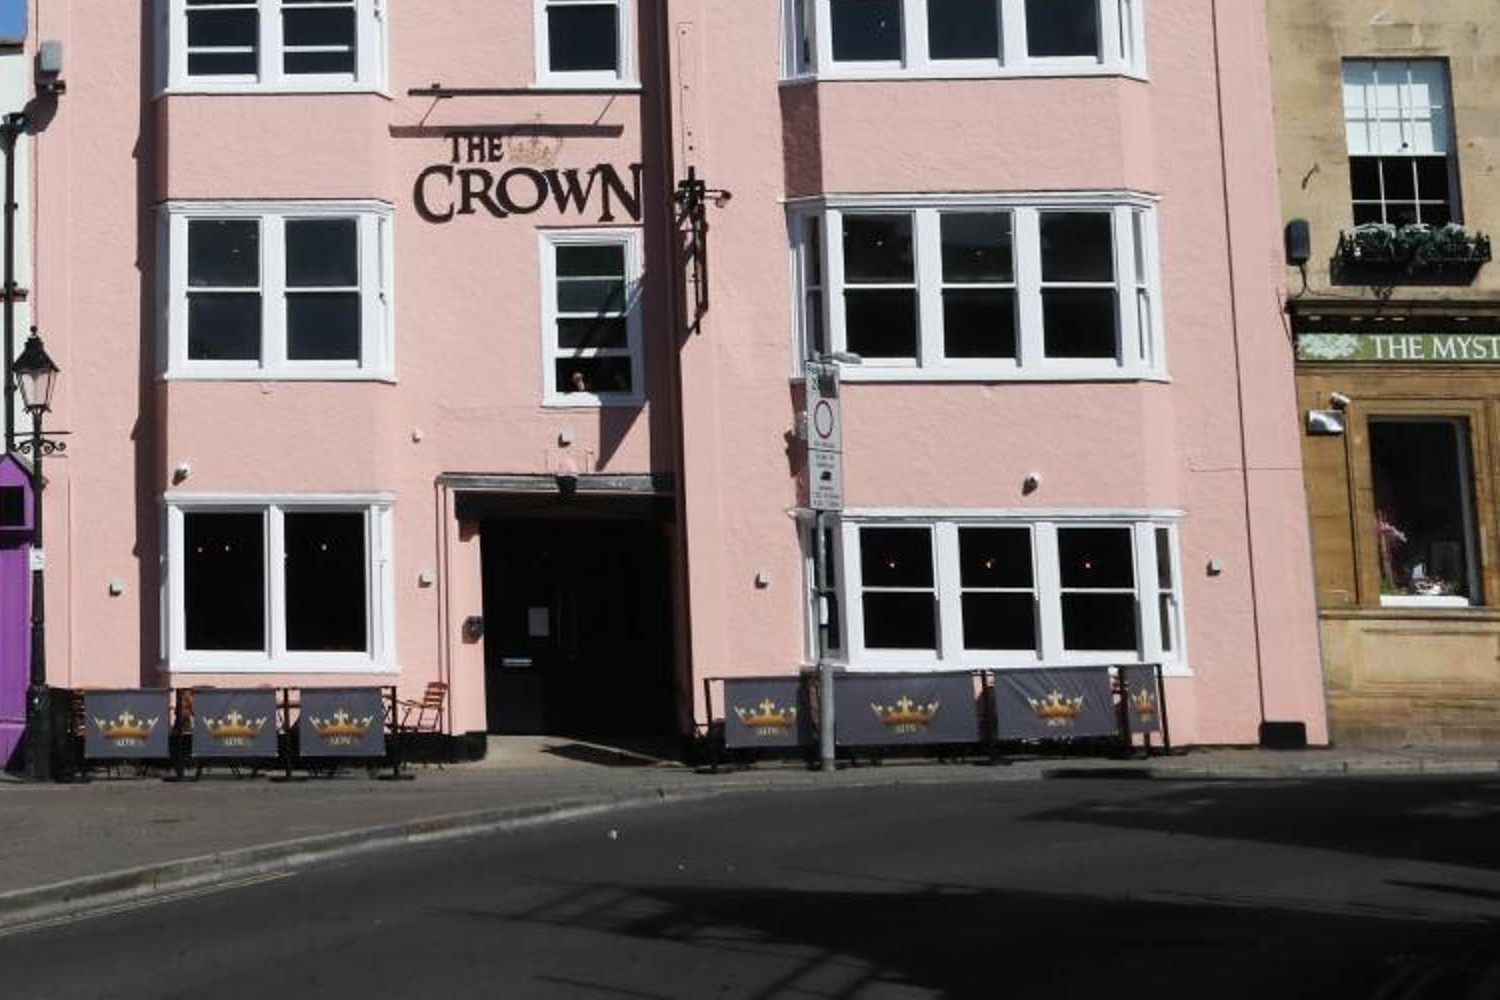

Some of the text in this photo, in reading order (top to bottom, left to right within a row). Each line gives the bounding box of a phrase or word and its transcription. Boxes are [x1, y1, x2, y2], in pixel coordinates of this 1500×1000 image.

[445, 135, 504, 163] THE
[414, 163, 643, 224] CROWN
[1369, 335, 1424, 359] THE
